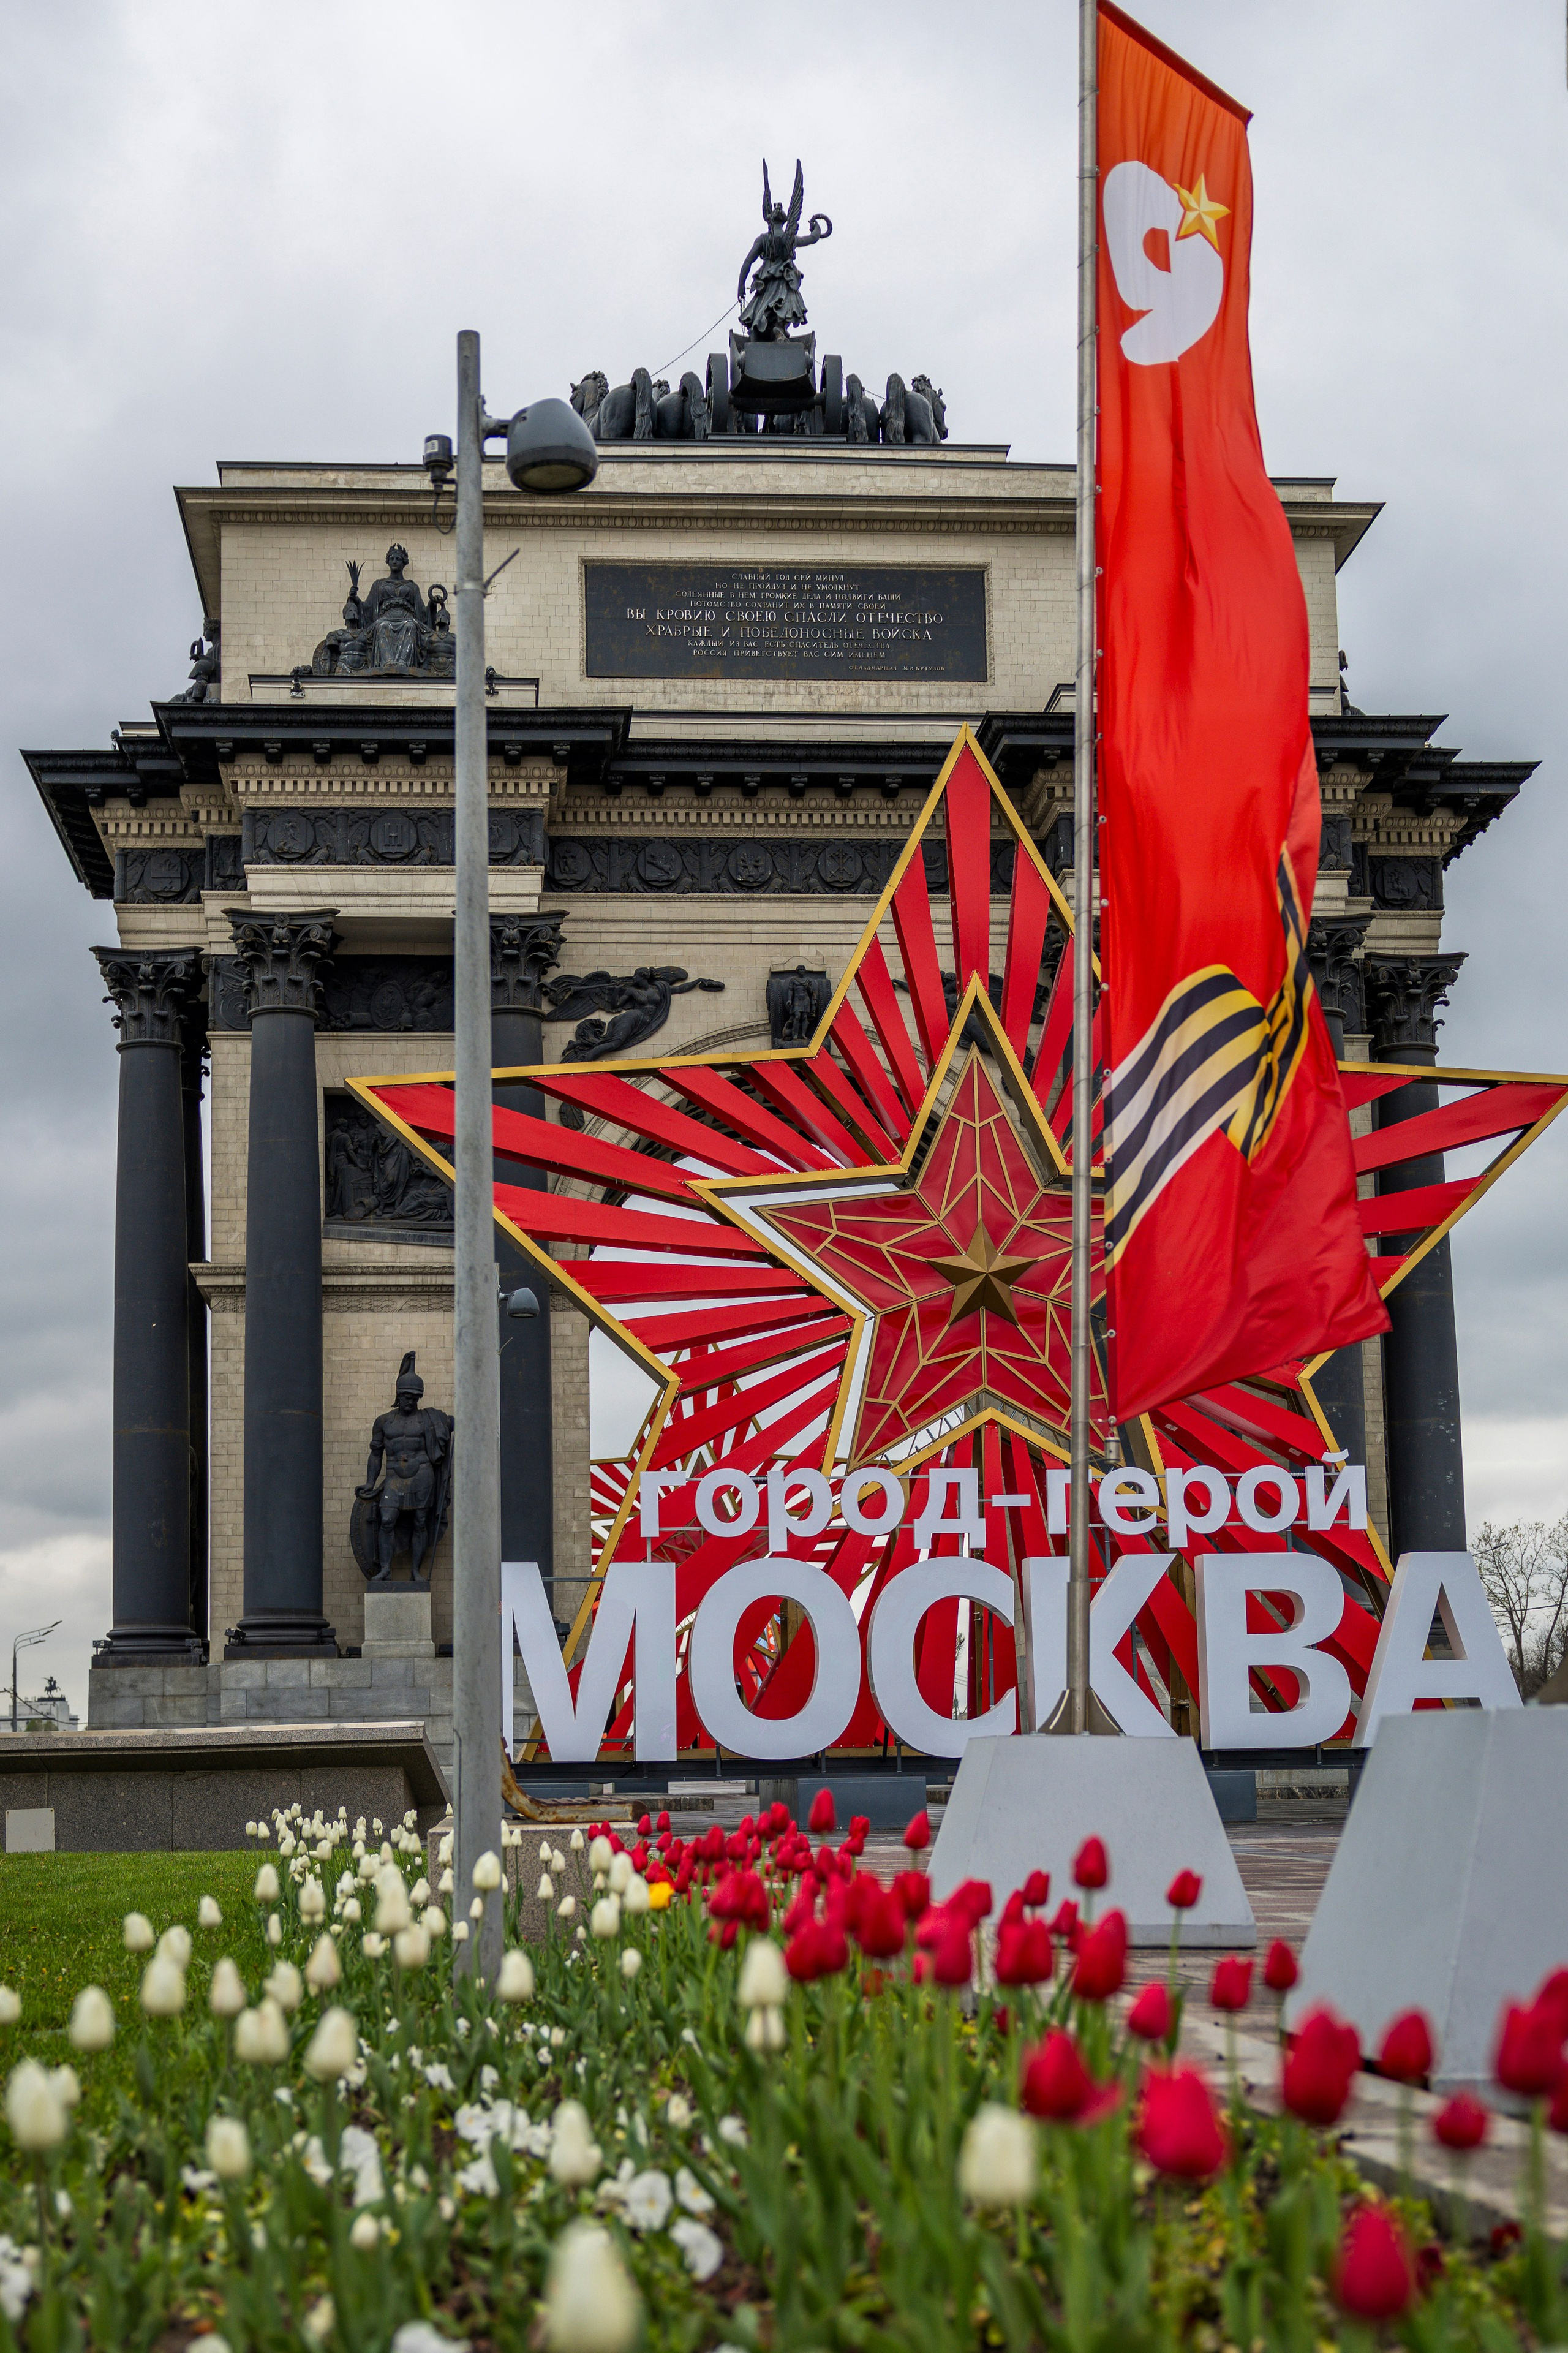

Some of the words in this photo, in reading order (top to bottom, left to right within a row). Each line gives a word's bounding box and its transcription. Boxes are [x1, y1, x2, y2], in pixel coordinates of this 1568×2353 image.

[626, 608, 646, 619] ВЫ
[656, 608, 715, 621] КРОВИЮ
[725, 610, 777, 622] СВОЕЮ
[785, 611, 846, 624] СПАСЛИ
[856, 612, 943, 625] ОТЕЧЕСТВО
[646, 625, 712, 637] ХРАБРЫЕ
[721, 626, 731, 638] И
[740, 627, 865, 640] ПОБЕДОНОСНЫЕ
[872, 627, 932, 640] ВОЙСКА
[501, 1550, 1524, 1761] МОСКВА
